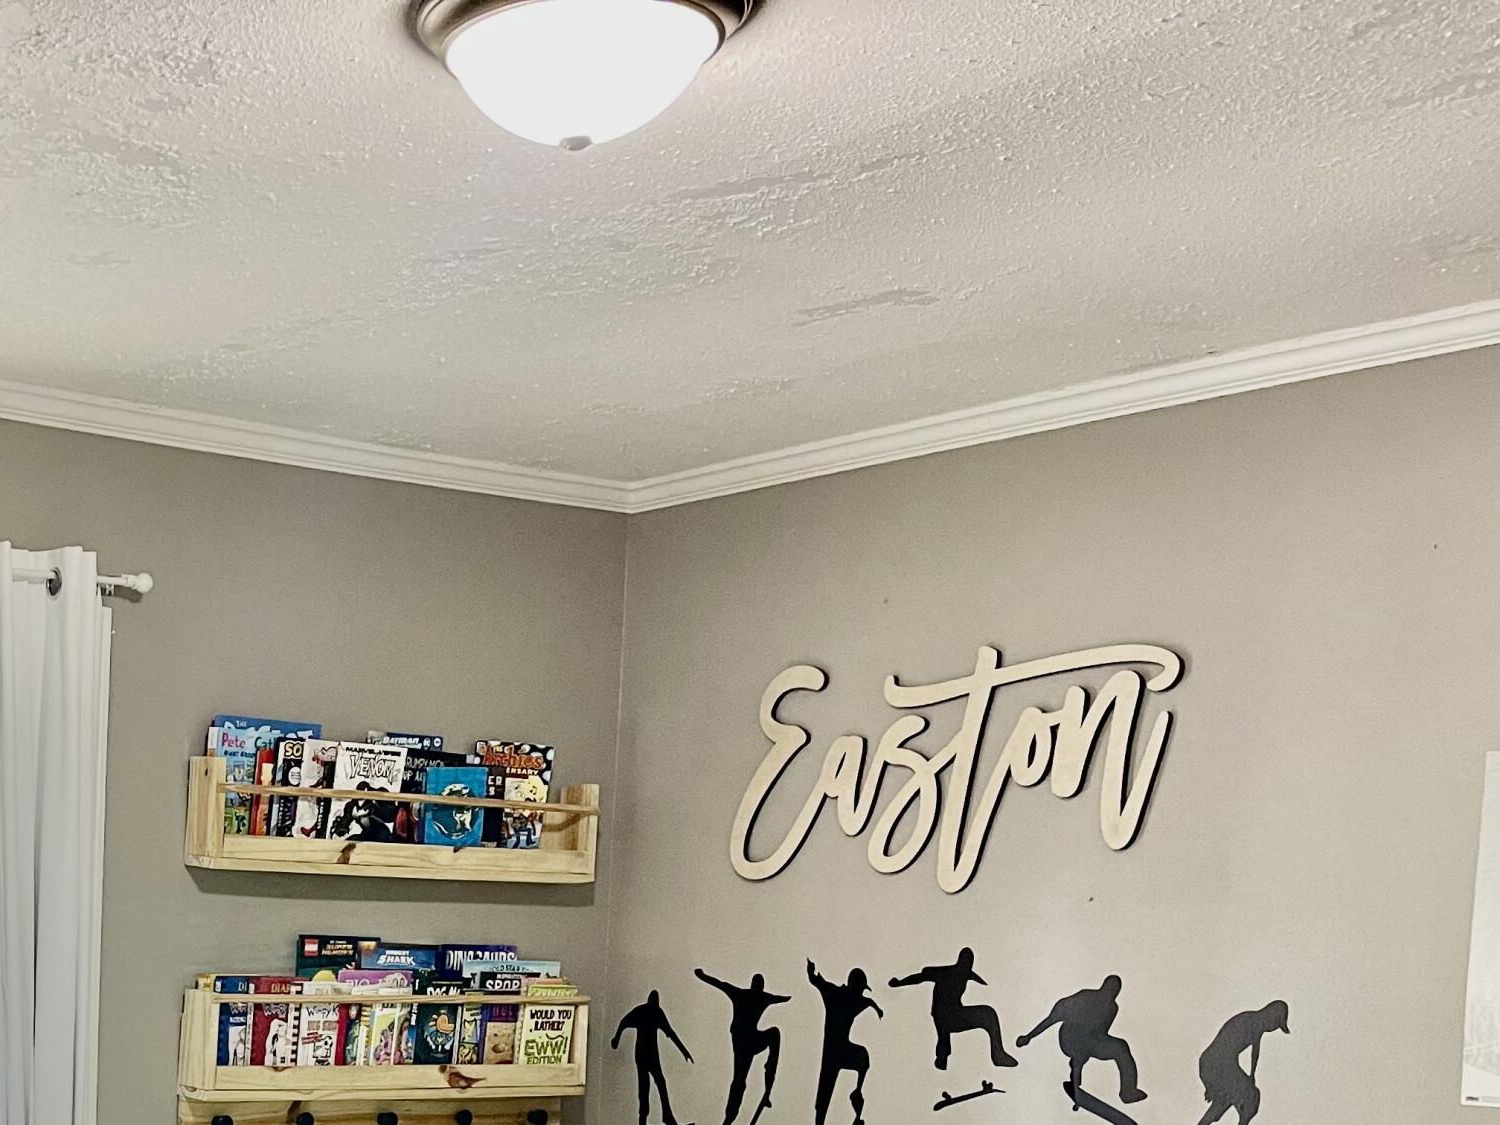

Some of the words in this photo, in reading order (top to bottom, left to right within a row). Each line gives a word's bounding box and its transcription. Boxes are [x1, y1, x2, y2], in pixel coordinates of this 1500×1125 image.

[222, 732, 246, 748] Pete
[349, 752, 396, 786] VENOM
[730, 644, 1185, 894] Easton
[377, 953, 416, 966] SHARK
[530, 1009, 555, 1020] WOULD
[557, 1009, 572, 1020] YOU
[524, 1037, 569, 1057] EWW!
[526, 1055, 563, 1065] EDITION
